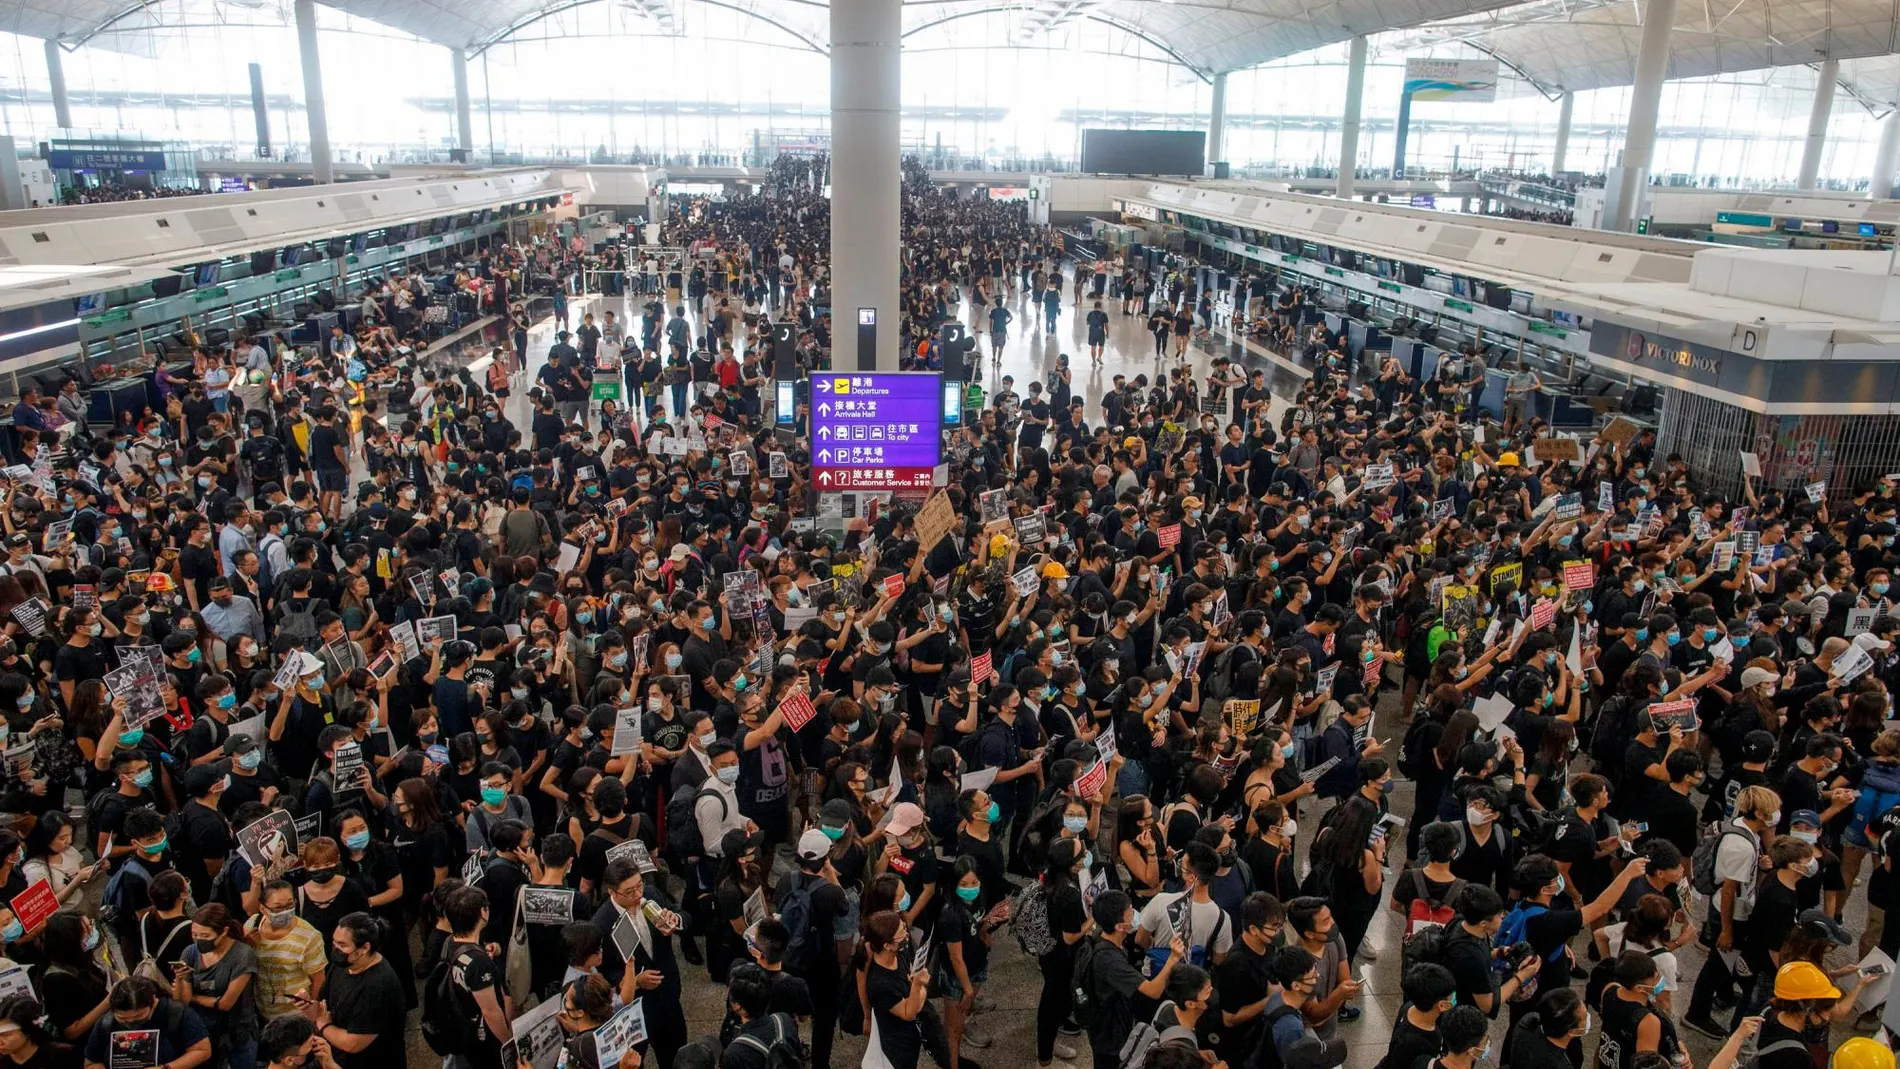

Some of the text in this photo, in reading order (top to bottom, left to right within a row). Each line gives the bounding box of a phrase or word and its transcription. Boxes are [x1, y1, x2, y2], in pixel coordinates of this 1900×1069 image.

[260, 146, 267, 155] E
[1743, 330, 1757, 351] D
[1647, 343, 1718, 374] VICTORINOX
[852, 377, 873, 387] 離港
[834, 401, 877, 410] 接機大堂
[897, 434, 909, 442] city
[852, 447, 884, 457] 停車場
[852, 470, 895, 479] 旅客服務
